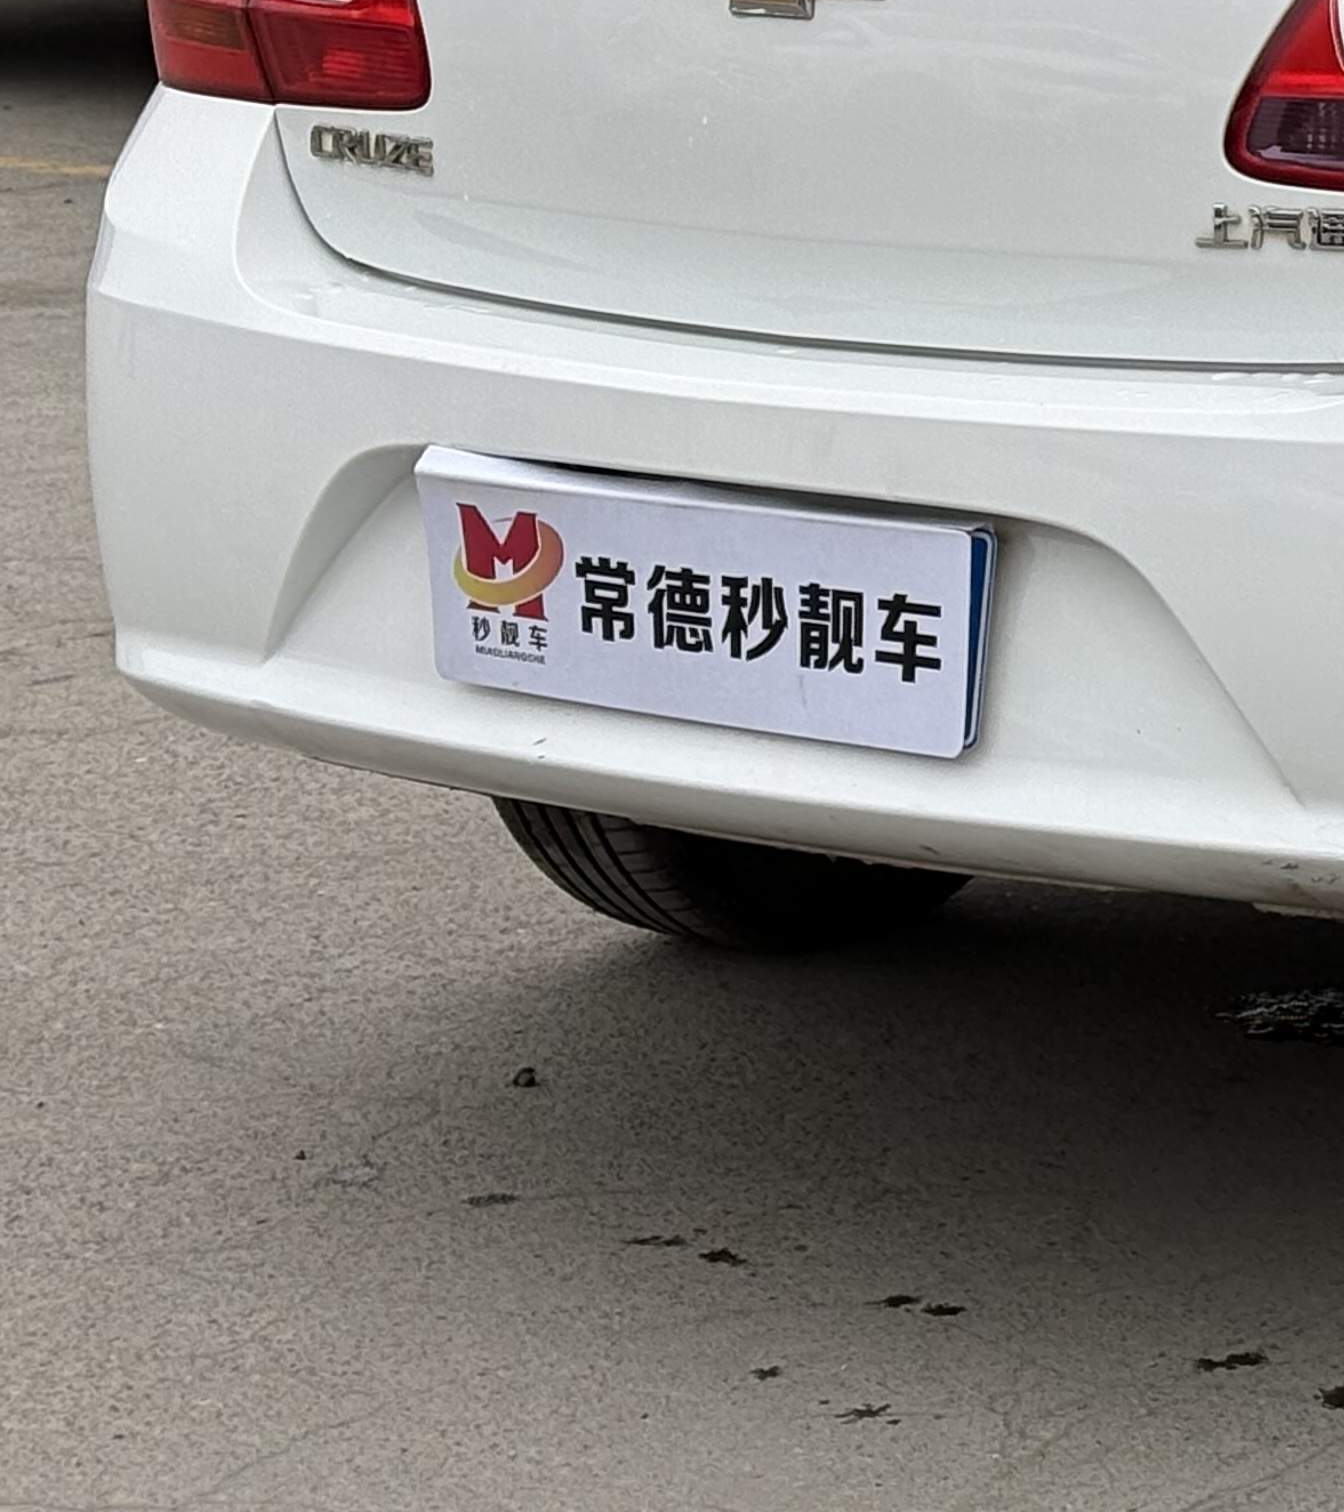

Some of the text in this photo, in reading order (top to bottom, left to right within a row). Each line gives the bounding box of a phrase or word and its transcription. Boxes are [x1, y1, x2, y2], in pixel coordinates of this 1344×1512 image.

[310, 125, 434, 178] CRUZE
[471, 615, 549, 652] 秒靓车
[574, 555, 943, 684] 常德秒靓车
